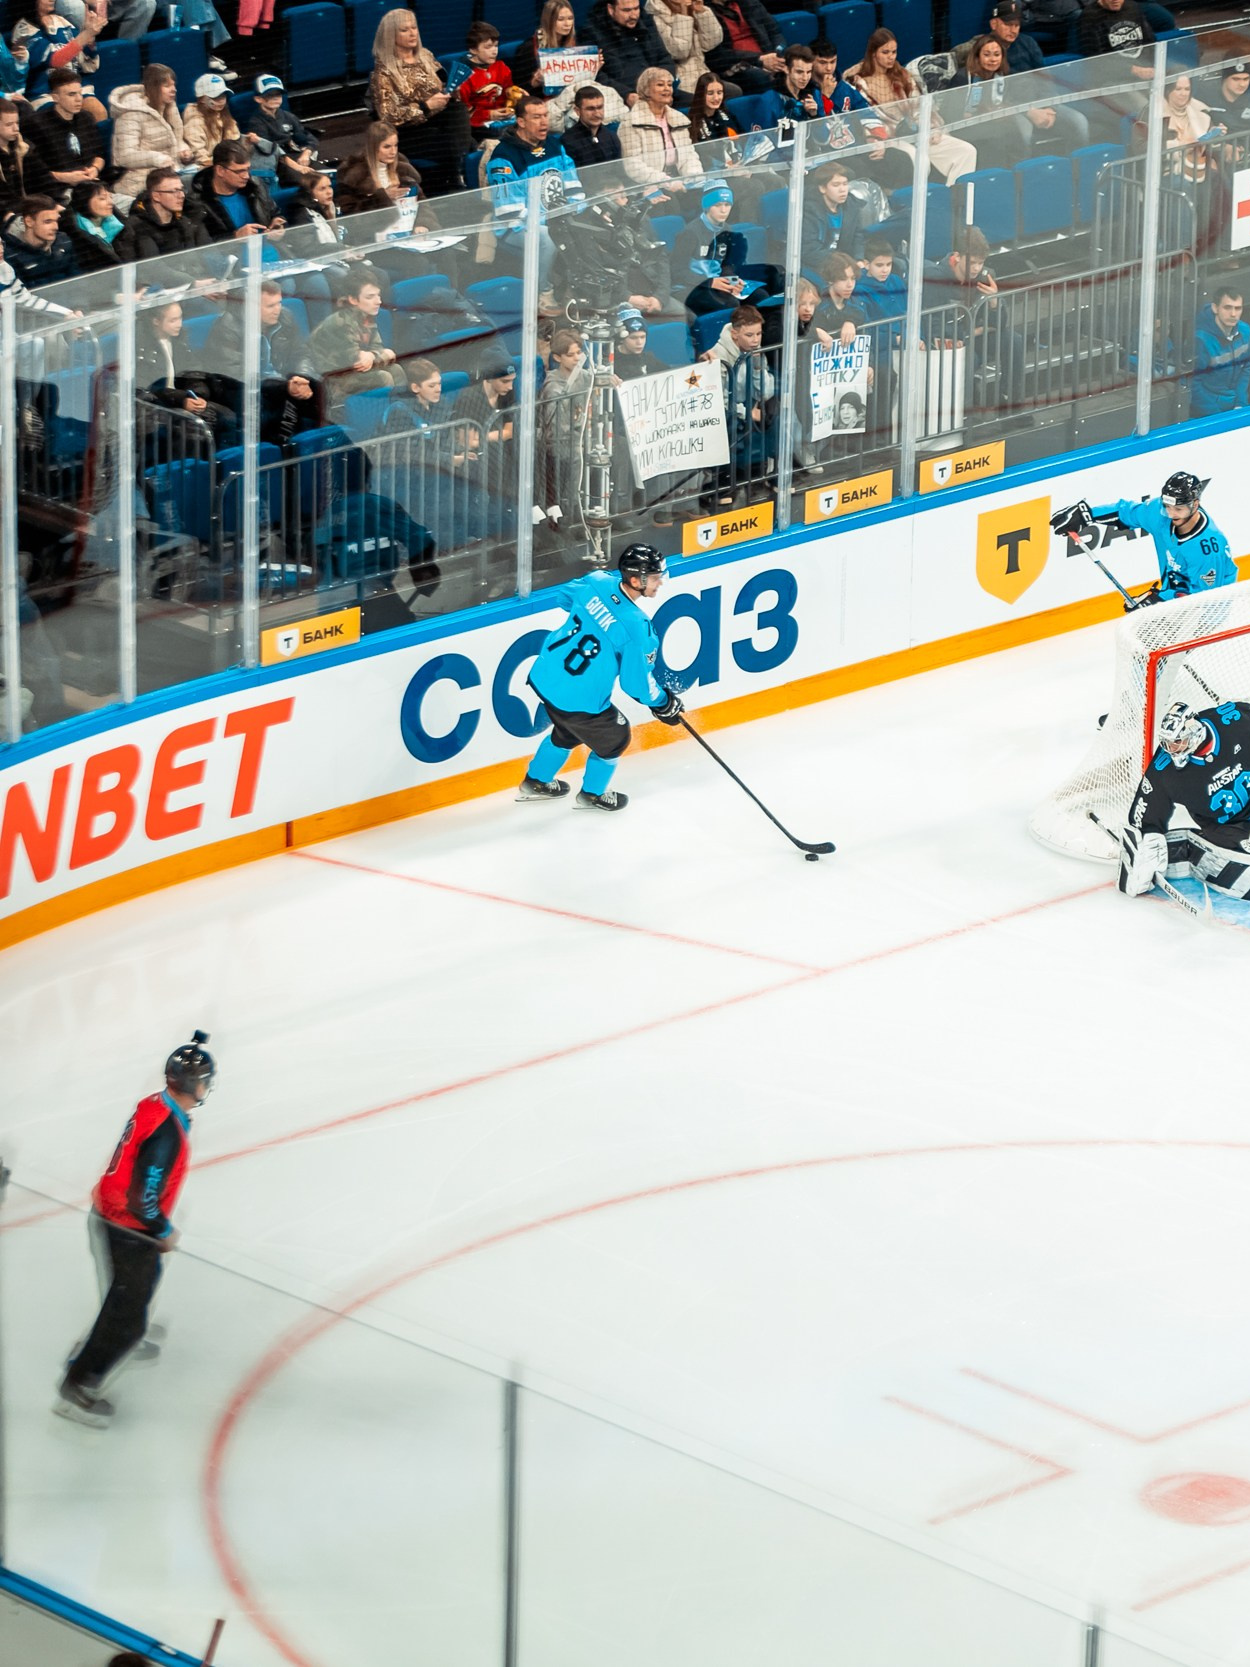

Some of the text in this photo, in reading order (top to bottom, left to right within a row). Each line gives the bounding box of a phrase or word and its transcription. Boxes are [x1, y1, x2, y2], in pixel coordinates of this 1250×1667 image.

[814, 355, 863, 375] МОЖНО
[817, 368, 861, 387] ФОТКУ
[658, 437, 704, 461] КЛЮШКУ
[938, 455, 991, 478] Т БАНК
[824, 485, 878, 508] Т БАНК
[703, 517, 758, 540] Т БАНК
[996, 527, 1031, 575] Т
[1200, 536, 1220, 555] 66
[585, 595, 618, 632] GUTIK
[283, 623, 344, 648] Т БАНК
[547, 614, 602, 676] 78
